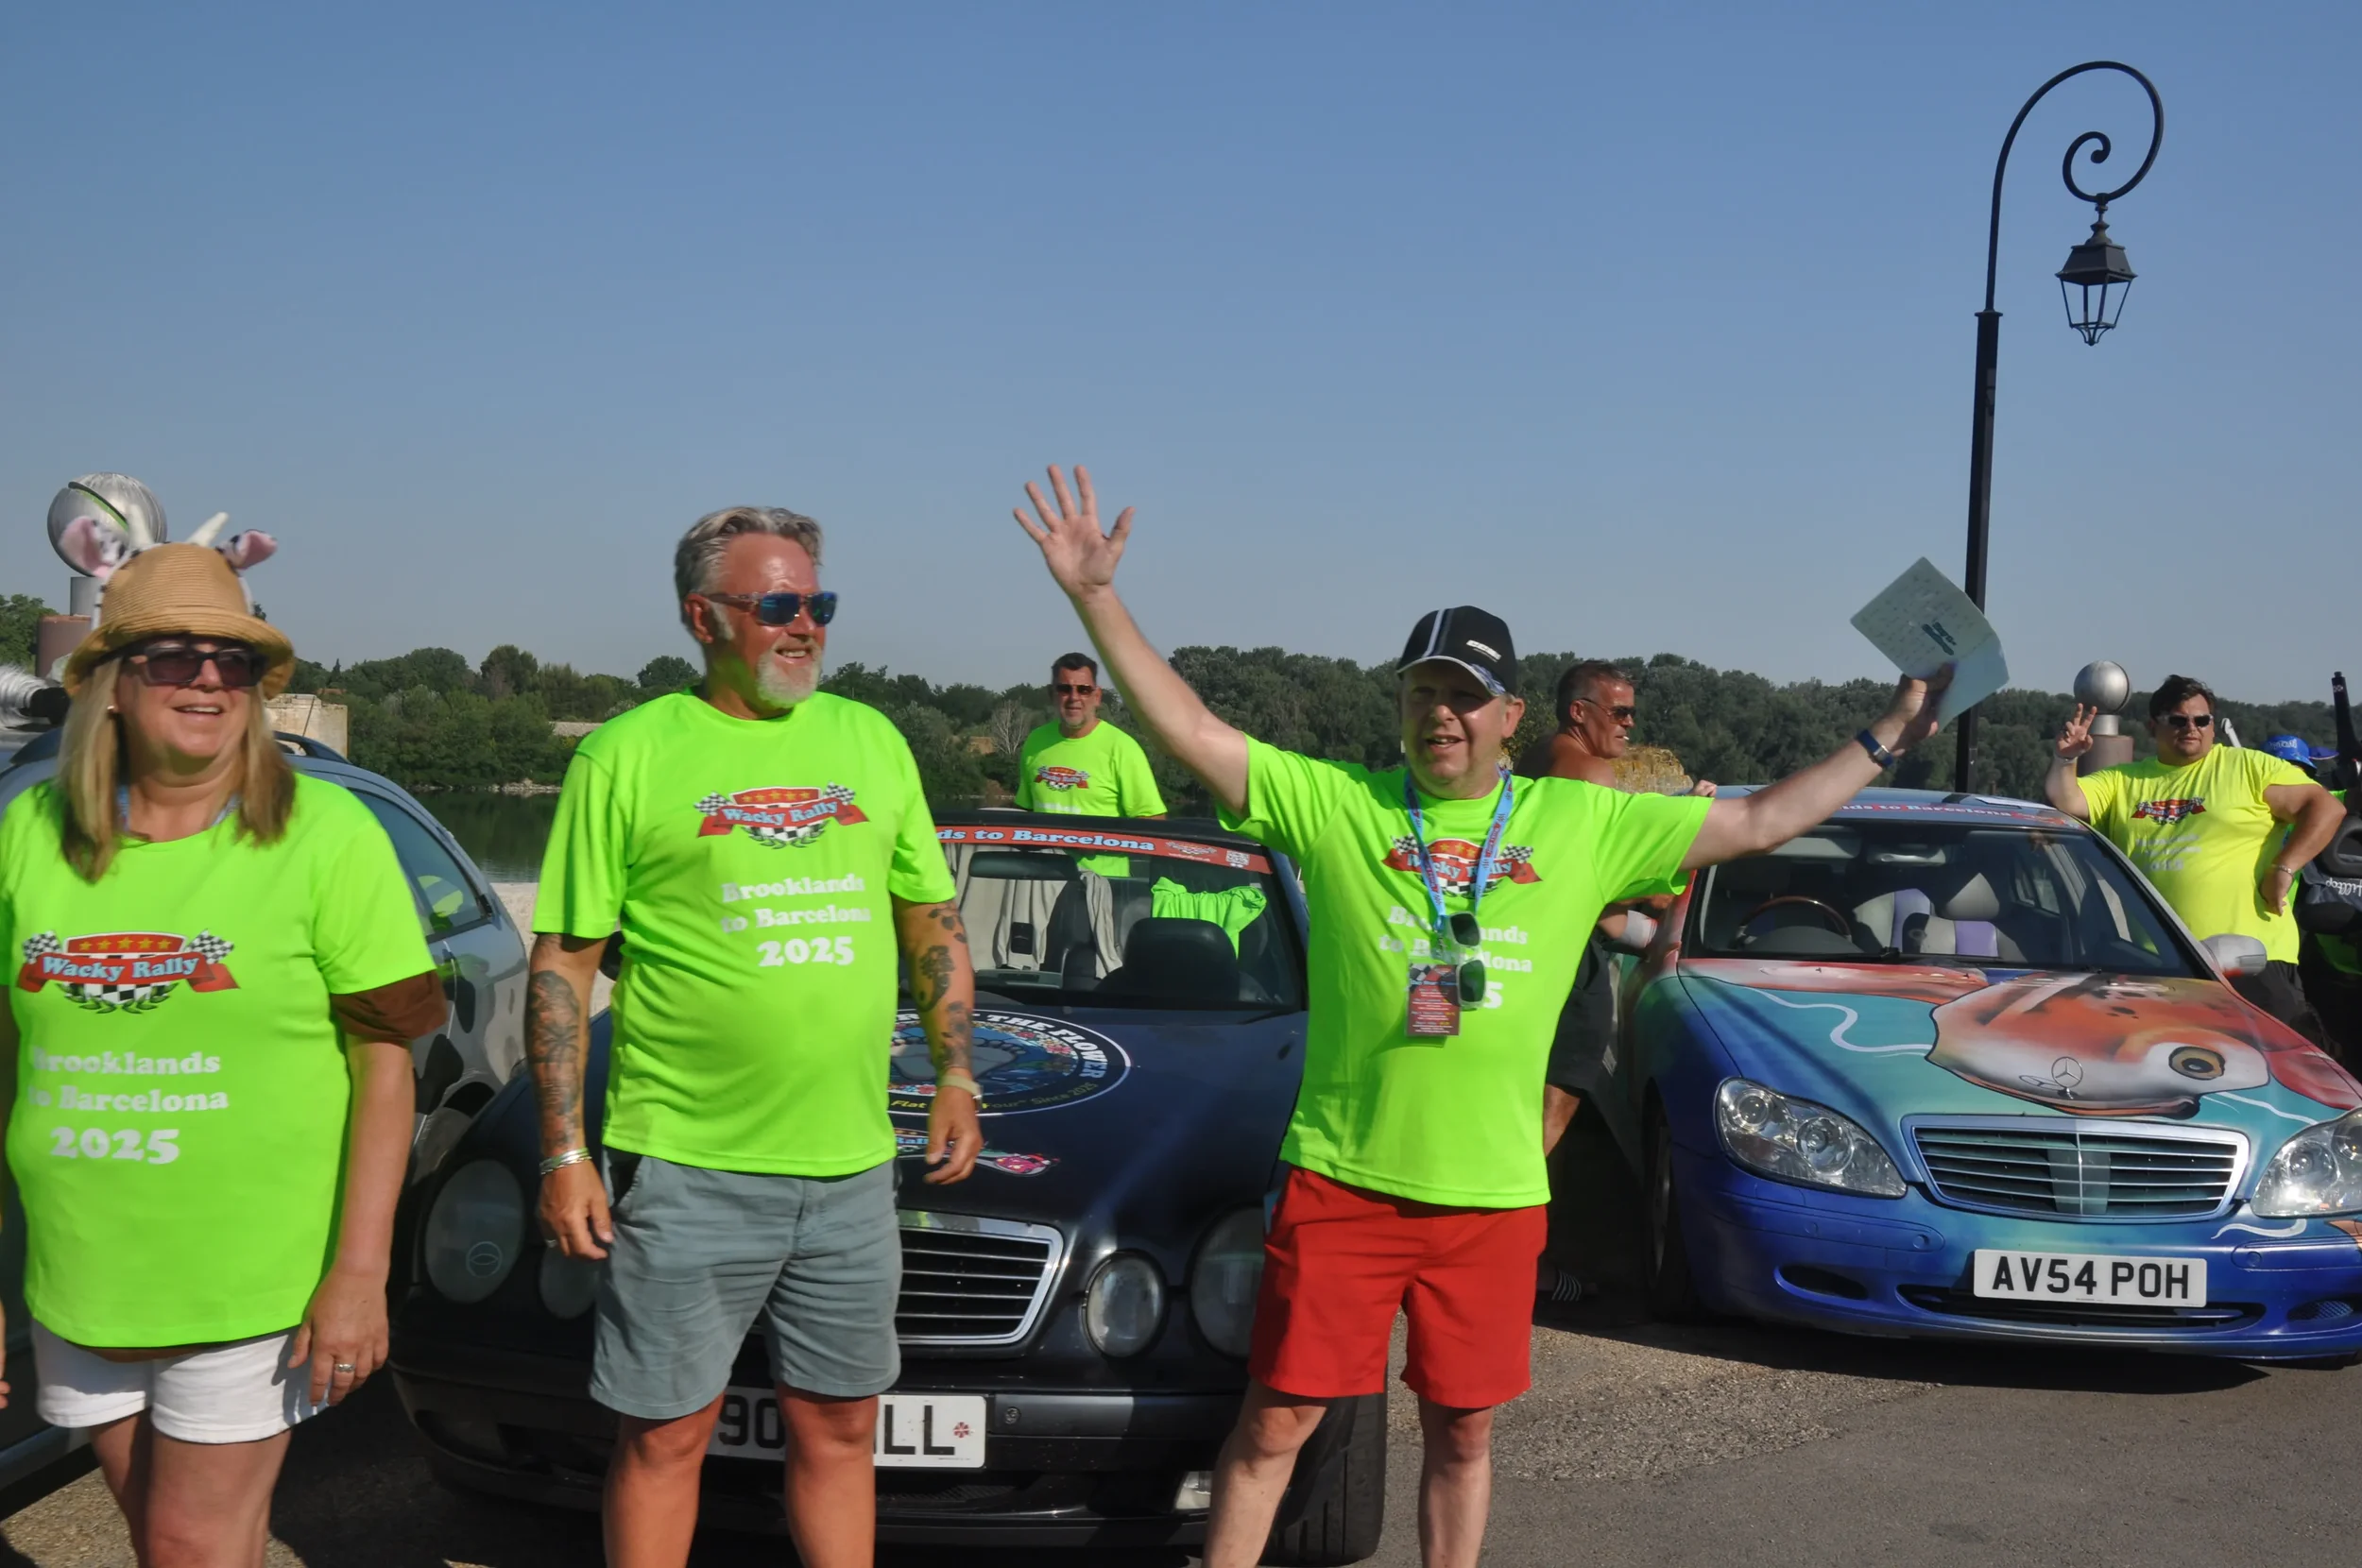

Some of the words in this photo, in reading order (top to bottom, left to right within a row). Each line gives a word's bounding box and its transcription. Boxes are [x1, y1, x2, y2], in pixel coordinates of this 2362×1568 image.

[722, 808, 785, 826] Wacky
[789, 801, 838, 822] Rally
[974, 829, 1004, 841] to
[1011, 829, 1155, 851] Barcelona
[1407, 853, 1461, 879] Wcky
[1466, 861, 1513, 878] Rlly
[721, 873, 865, 903] Brooklands
[720, 916, 748, 934] to
[753, 904, 872, 929] Barcelona
[1388, 905, 1529, 945] Brands
[756, 936, 855, 967] 2025
[1378, 934, 1405, 953] to
[1412, 937, 1533, 974] Blona
[43, 956, 124, 980] Wacky
[132, 955, 199, 978] Rally
[31, 1045, 221, 1075] Brooklands
[986, 1014, 1056, 1031] THE
[1048, 1028, 1108, 1079] FLOWER
[58, 1084, 230, 1113] Barcelona
[890, 1099, 928, 1109] Flat
[1031, 1093, 1070, 1105] Since
[49, 1126, 180, 1165] 2025
[1992, 1255, 2097, 1295] AV54
[2111, 1261, 2189, 1300] POH
[717, 1394, 788, 1449] 90
[871, 1404, 955, 1456] LL
